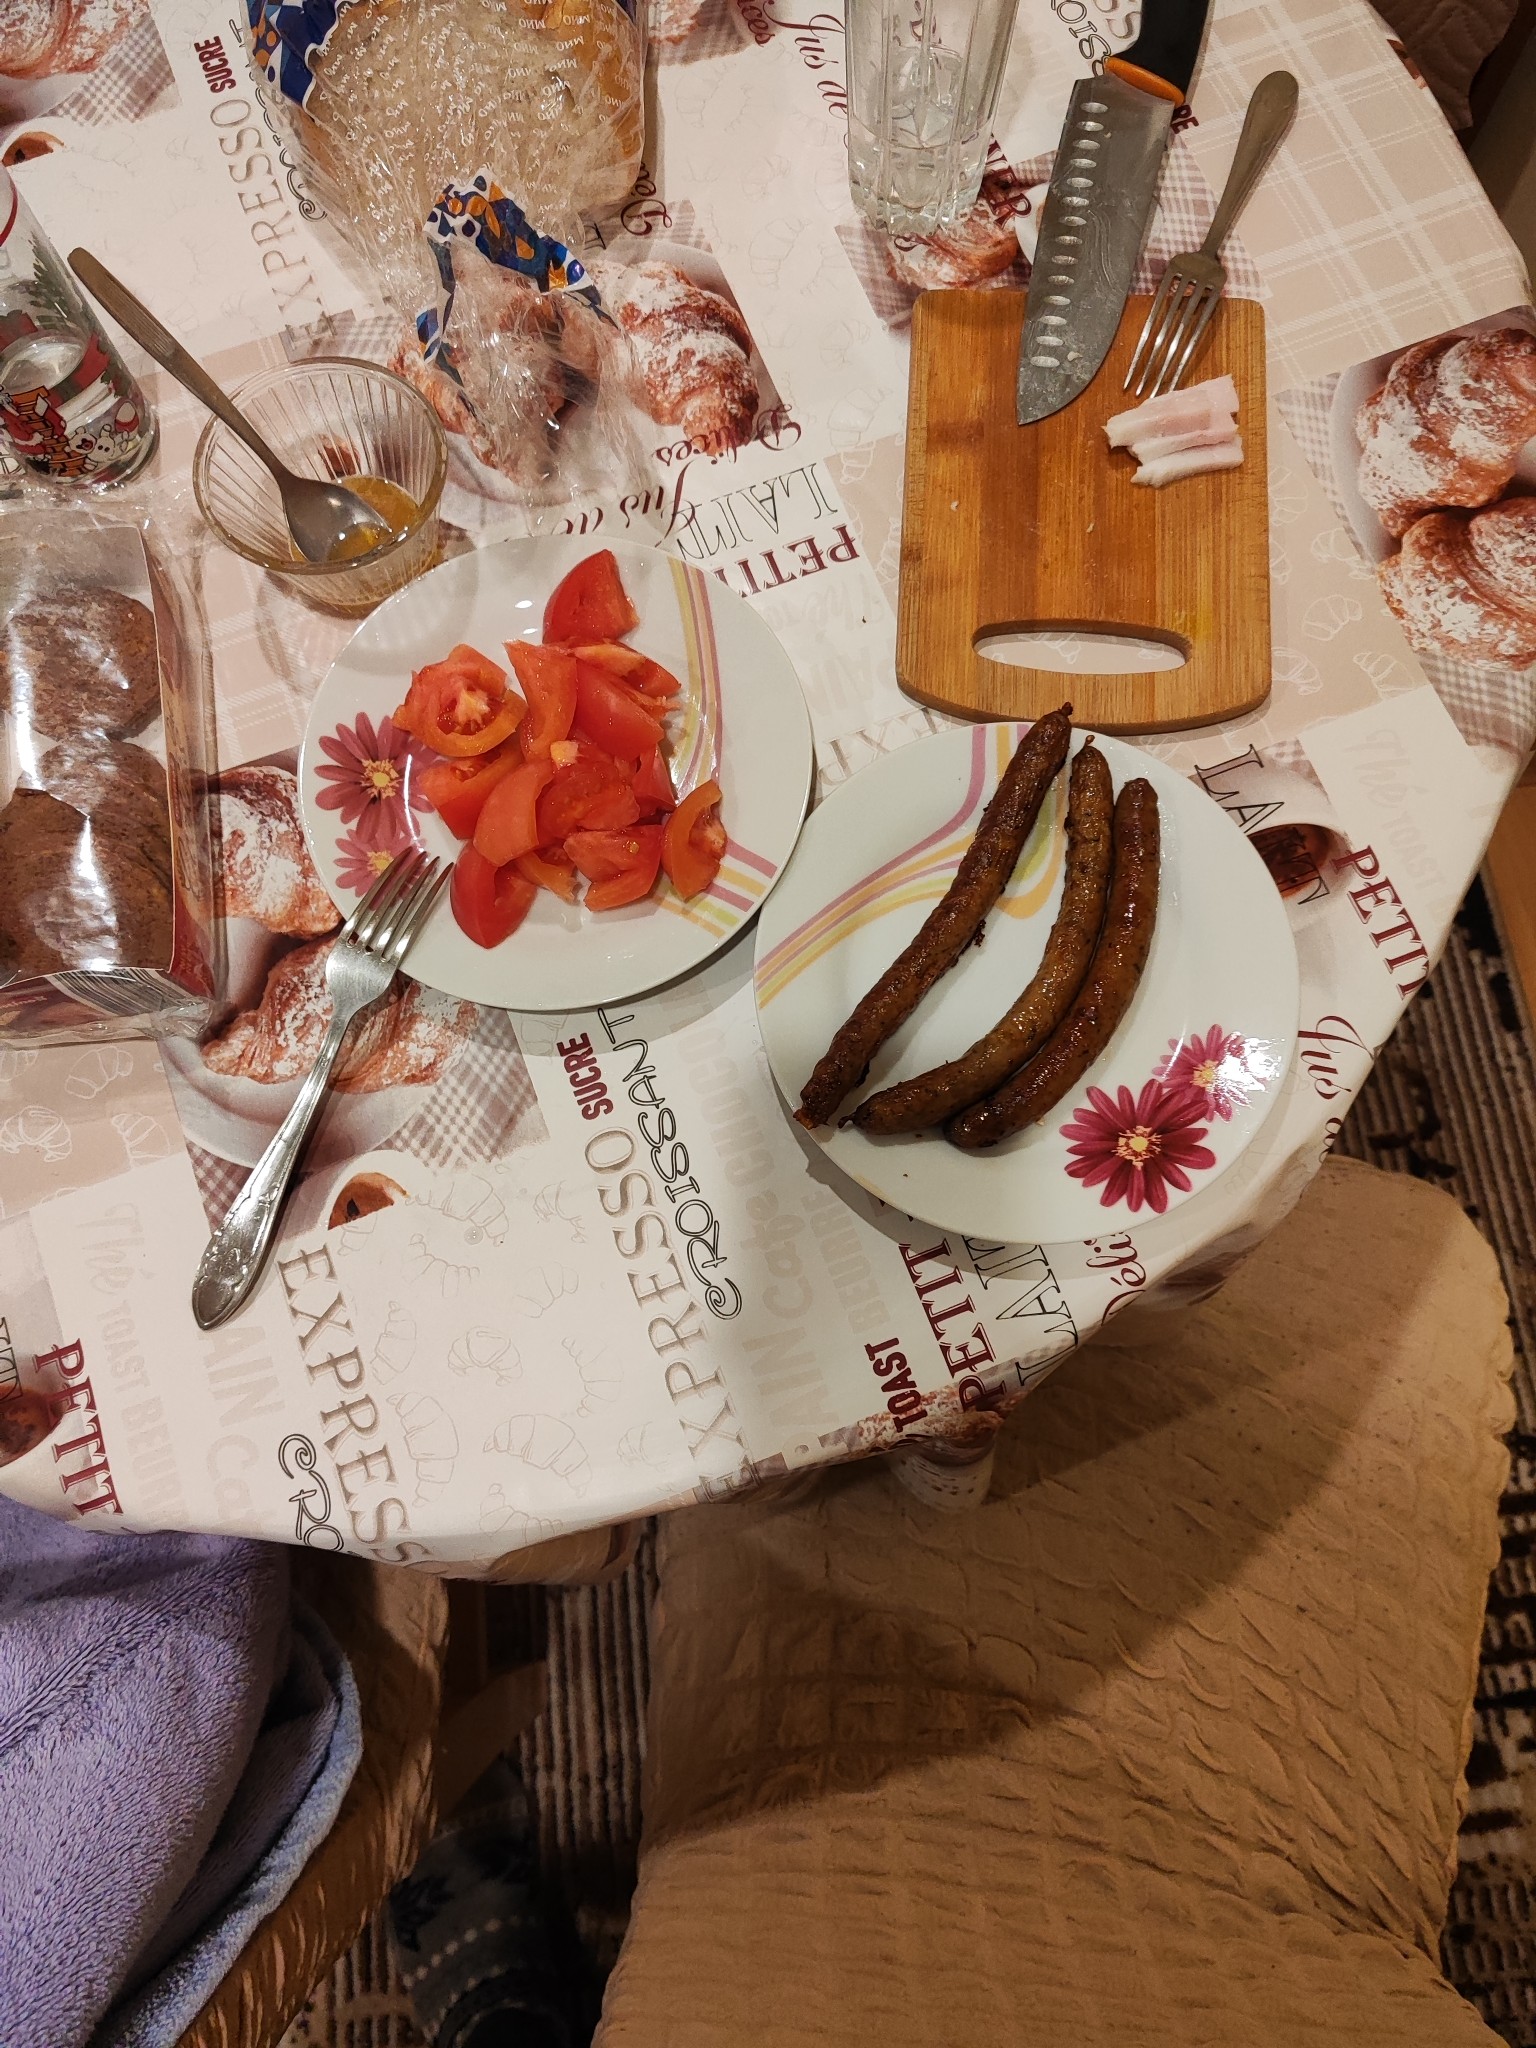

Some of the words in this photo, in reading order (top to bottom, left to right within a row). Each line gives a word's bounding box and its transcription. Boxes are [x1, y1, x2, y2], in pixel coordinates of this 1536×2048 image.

[194, 36, 237, 93] SUCRE
[676, 462, 840, 560] LAIT
[556, 1032, 614, 1121] SUCRE
[597, 1007, 743, 1320] CROISSANT
[898, 1238, 1007, 1412] PETIT
[33, 1338, 124, 1516] PETIT
[863, 1337, 928, 1433] TOAST
